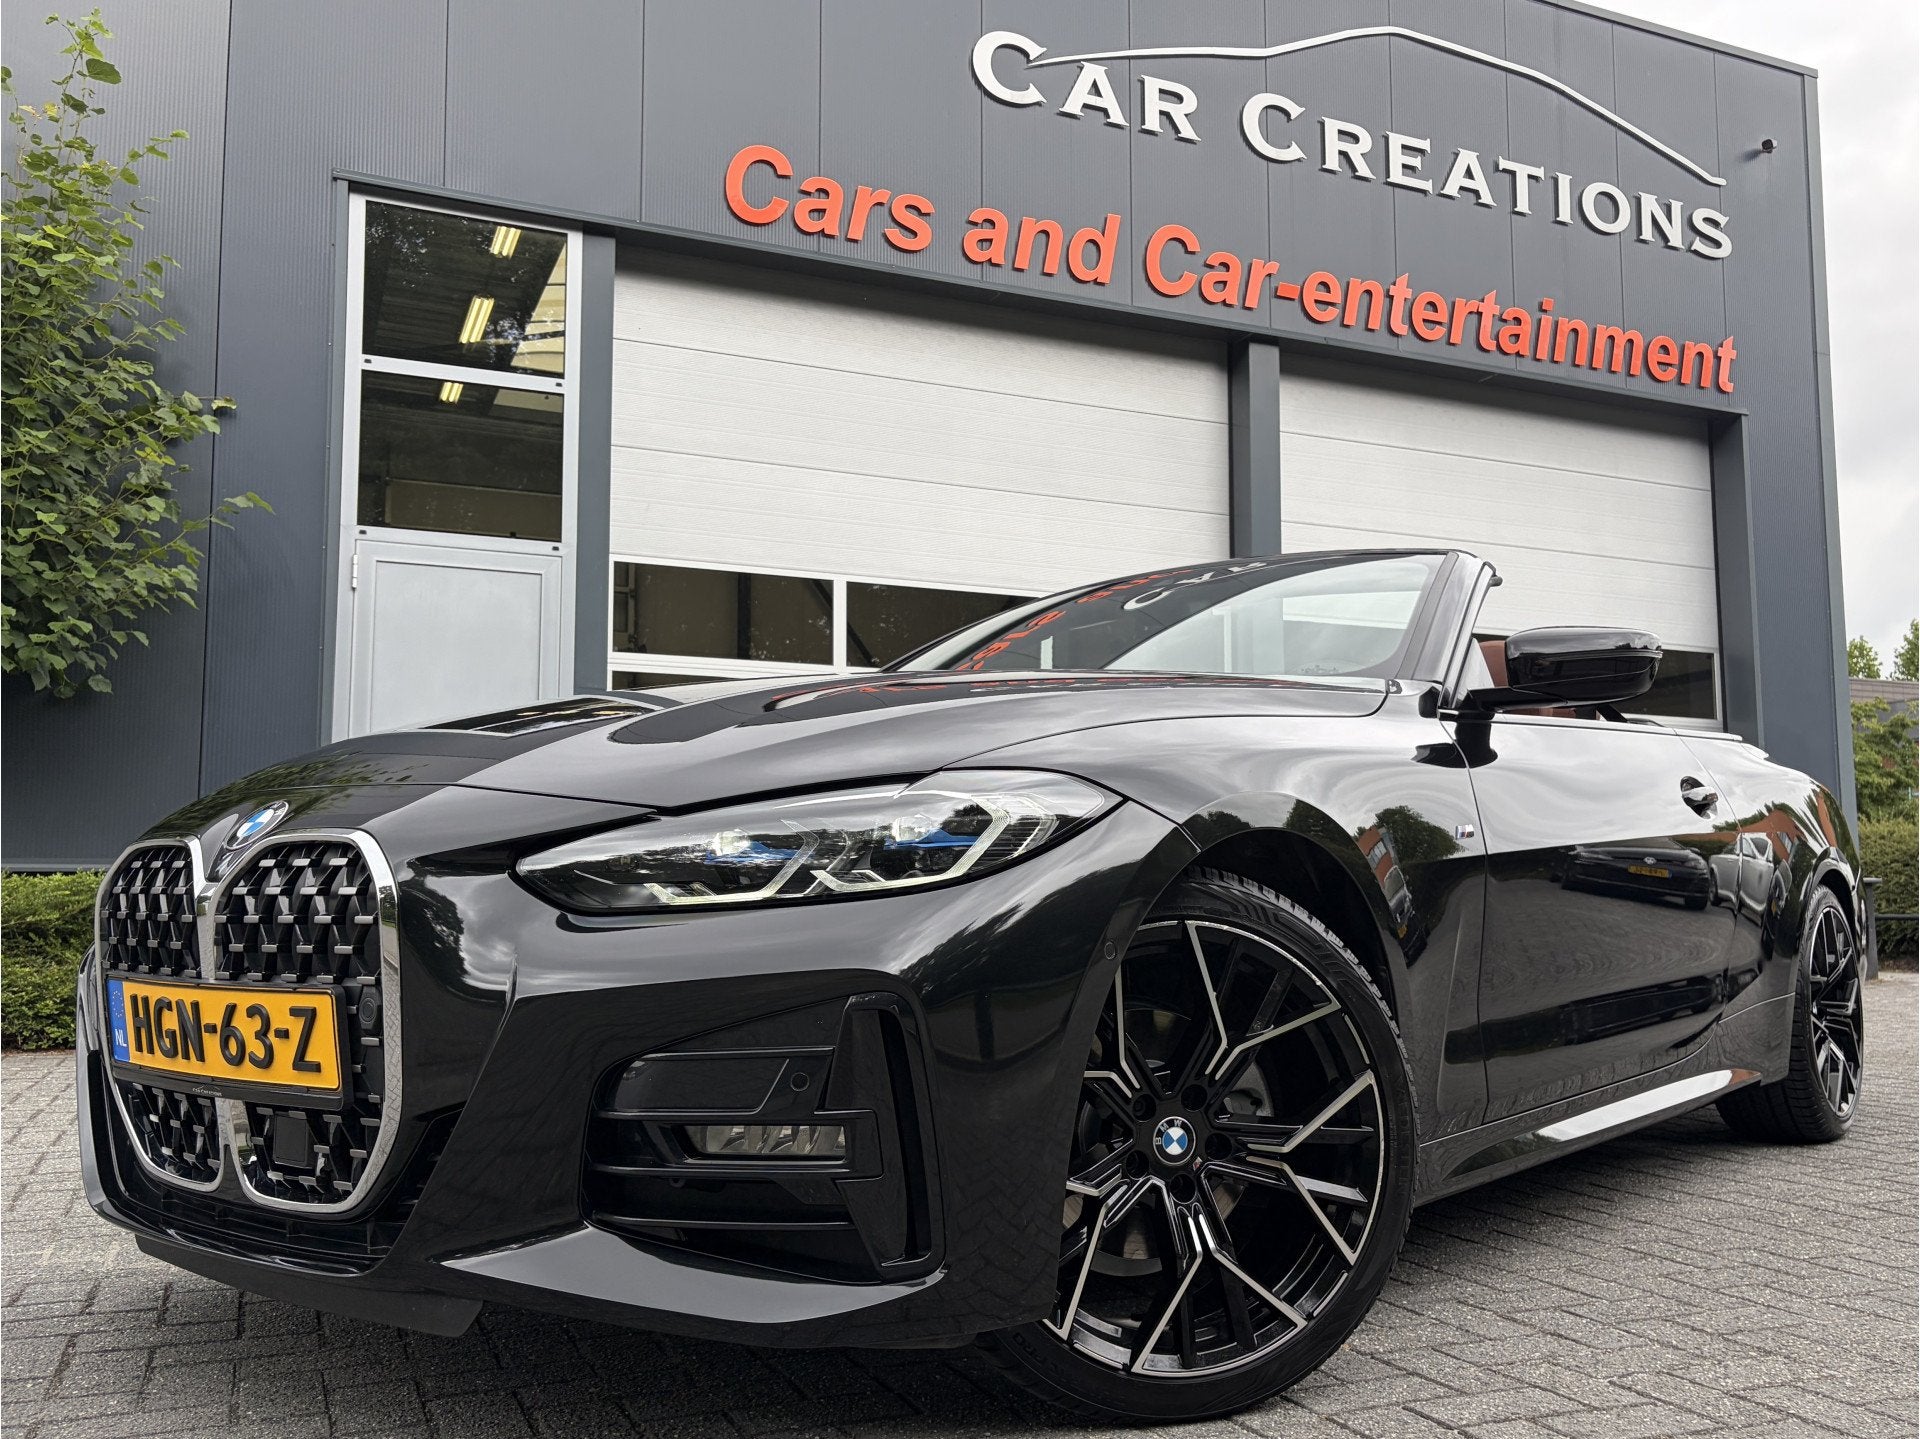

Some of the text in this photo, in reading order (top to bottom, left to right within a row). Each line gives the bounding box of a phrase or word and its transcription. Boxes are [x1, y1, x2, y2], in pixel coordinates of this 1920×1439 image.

[973, 31, 1733, 259] CAR CREATIONS
[726, 146, 1738, 393] Cars and Car-entertainment
[114, 1029, 127, 1047] NL
[129, 993, 322, 1073] HGN-63-Z
